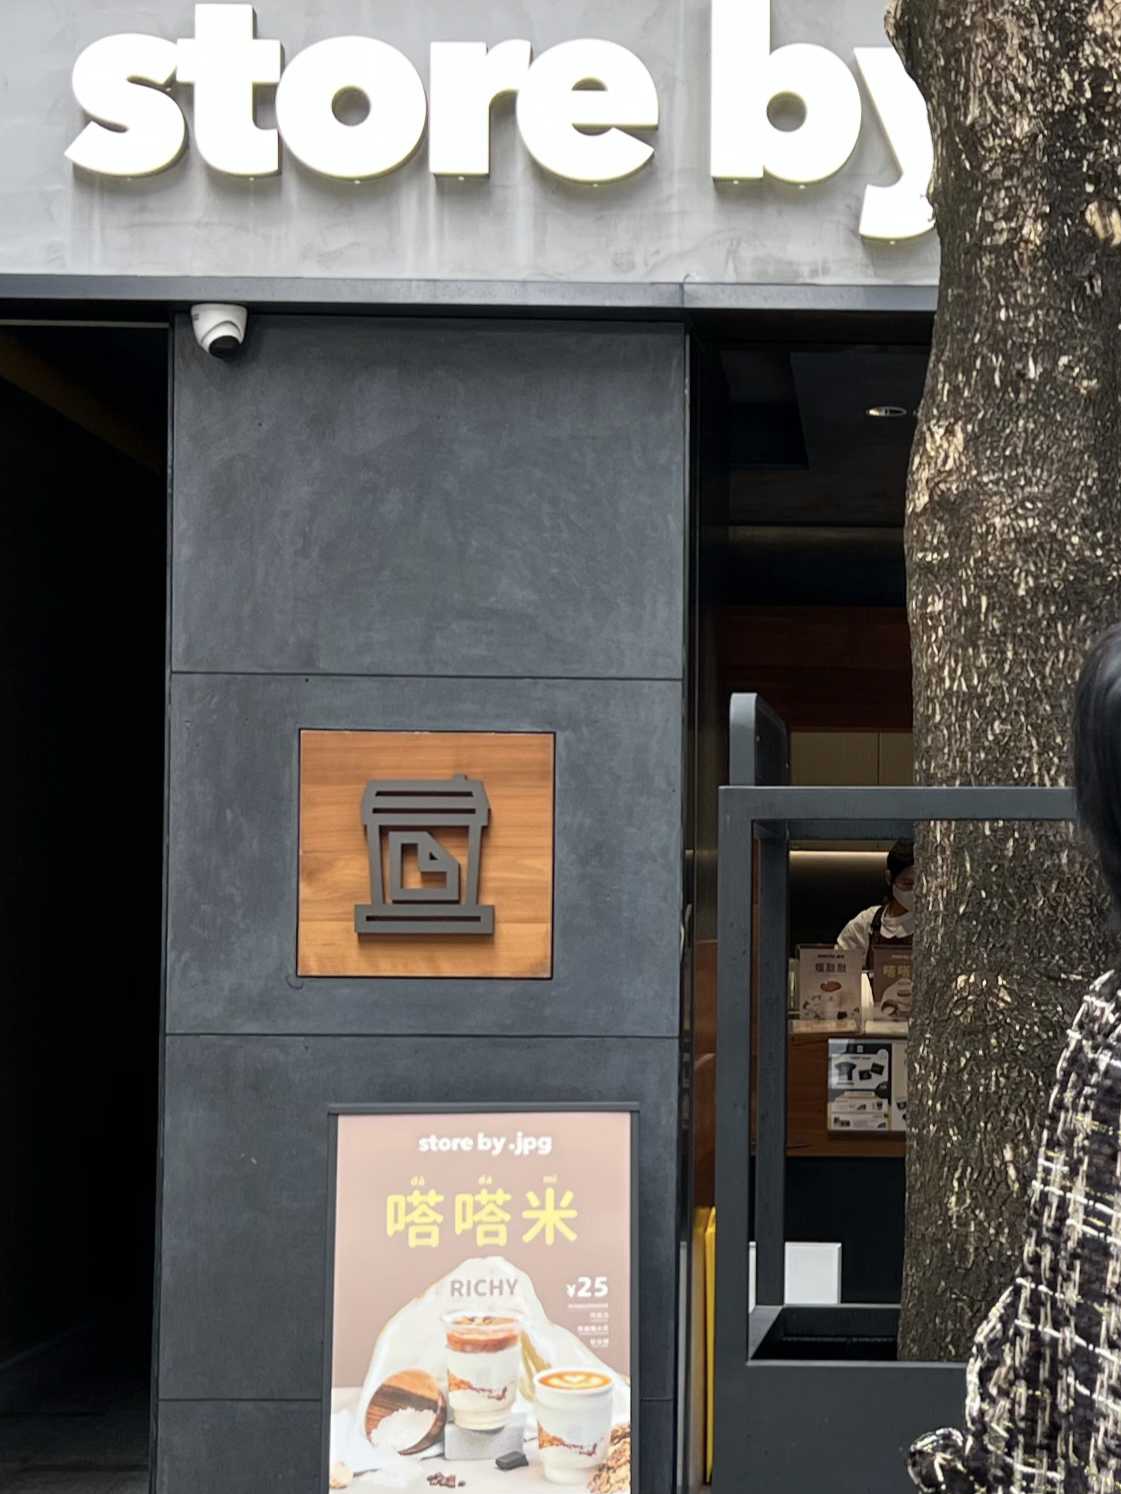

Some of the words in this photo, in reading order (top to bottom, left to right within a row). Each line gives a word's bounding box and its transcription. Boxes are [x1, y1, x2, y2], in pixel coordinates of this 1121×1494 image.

[64, 3, 660, 182] store
[418, 1134, 474, 1152] store
[477, 1132, 507, 1156] by
[508, 1131, 553, 1156] .jpg
[386, 1187, 579, 1249] 嗒嗒米
[450, 1278, 518, 1297] RICHY
[566, 1276, 609, 1298] ¥25
